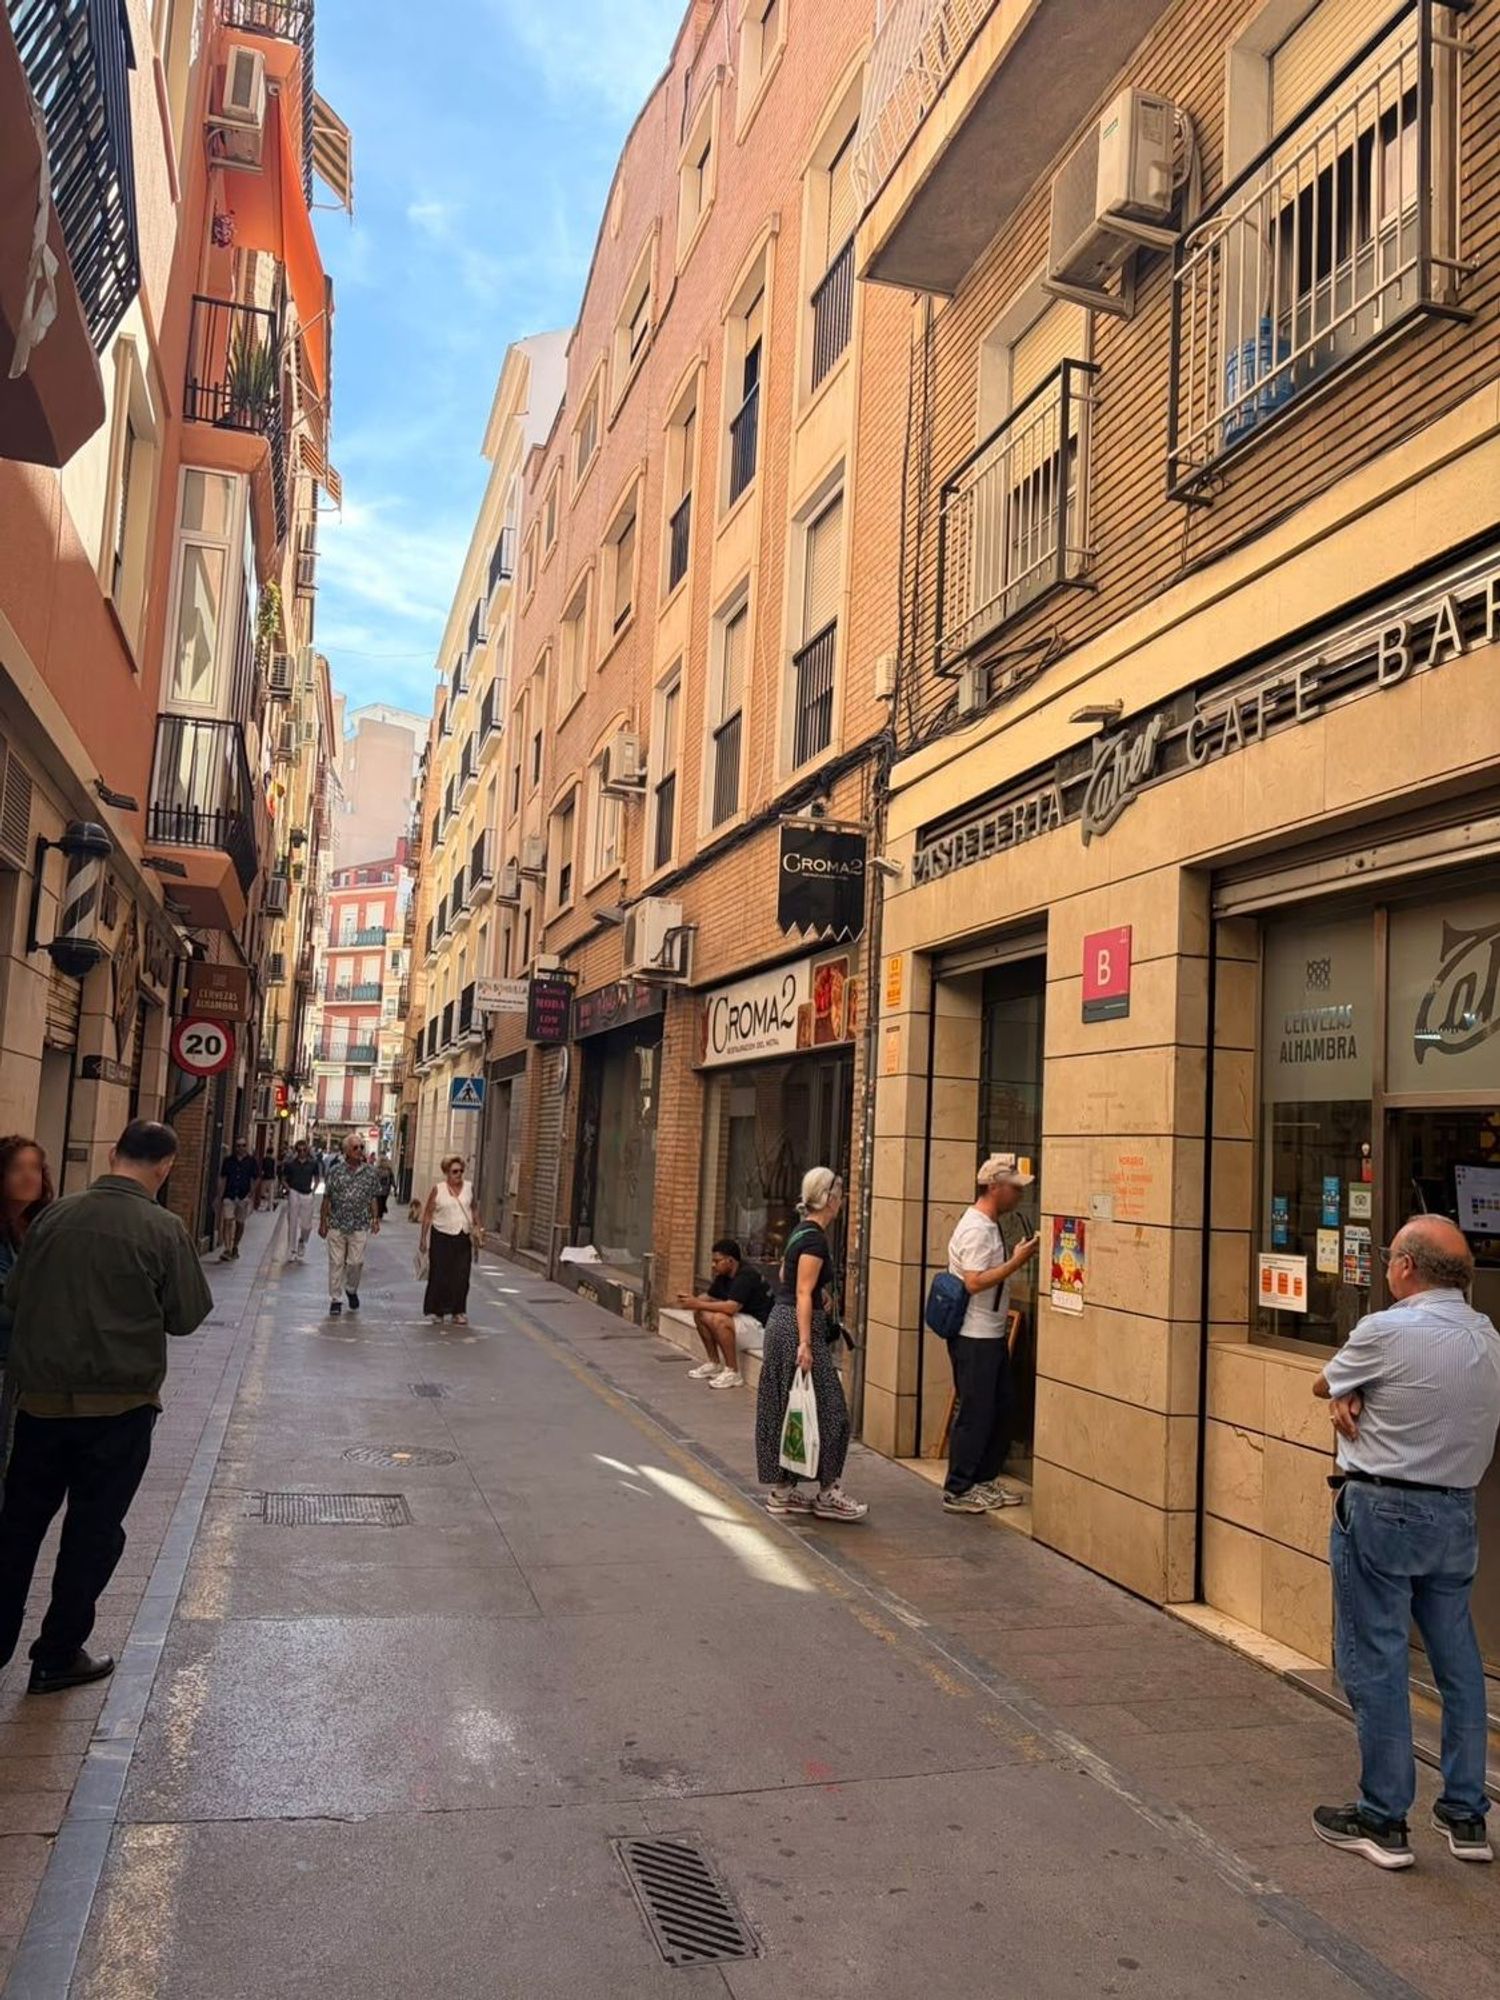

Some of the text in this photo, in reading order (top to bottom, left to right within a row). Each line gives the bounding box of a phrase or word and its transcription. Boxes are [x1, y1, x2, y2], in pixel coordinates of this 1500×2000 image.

[911, 784, 1064, 888] PASTELERIA
[1186, 656, 1326, 768] CAFE
[782, 852, 864, 876] CROMA2
[1097, 948, 1111, 986] B
[711, 973, 797, 1054] CROMA2
[1284, 1005, 1353, 1035] CERVEZAS
[185, 1034, 223, 1056] 20
[1280, 1034, 1358, 1064] ALHAMBRA
